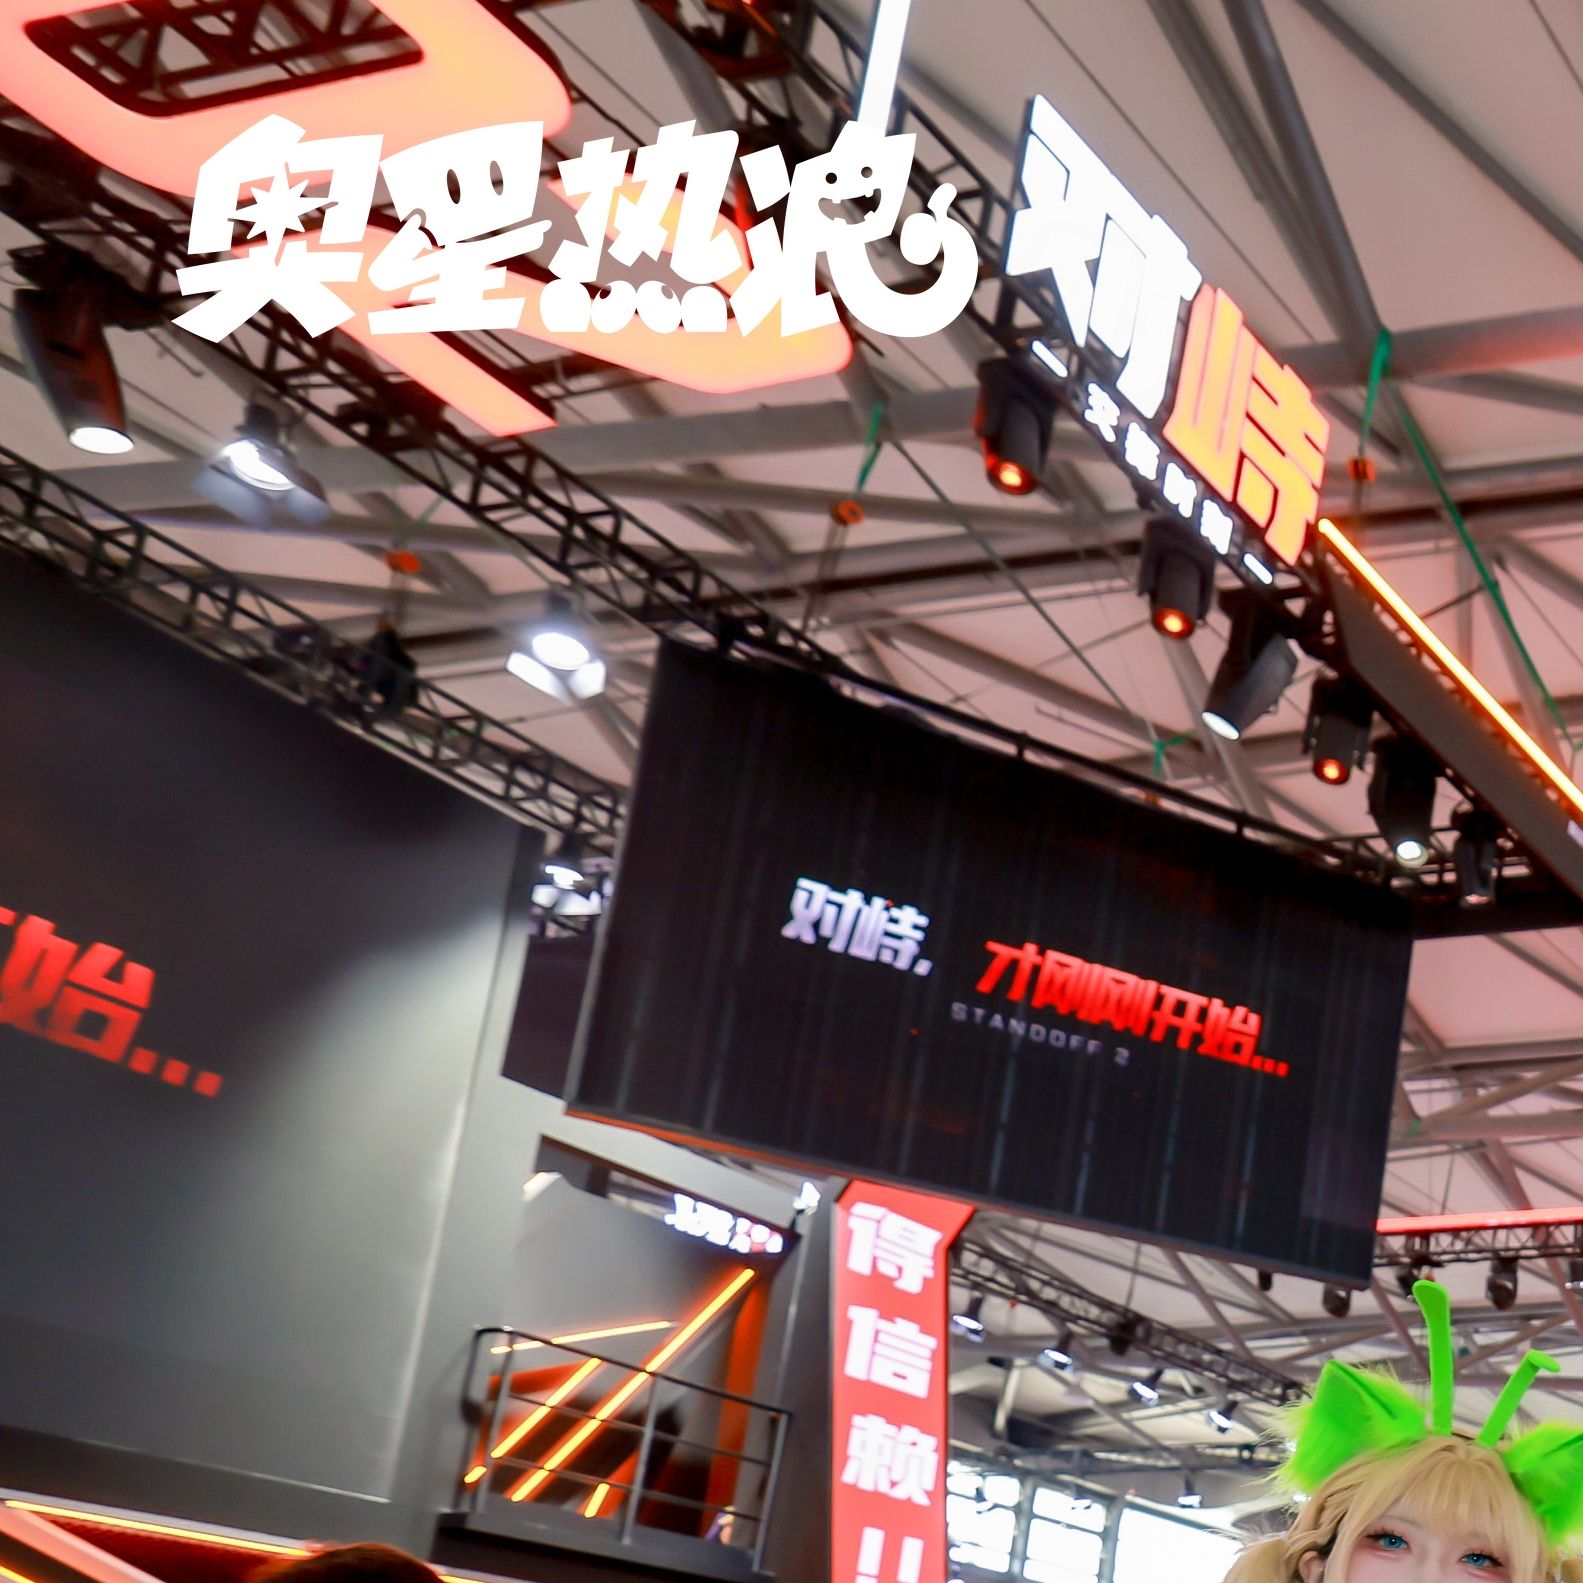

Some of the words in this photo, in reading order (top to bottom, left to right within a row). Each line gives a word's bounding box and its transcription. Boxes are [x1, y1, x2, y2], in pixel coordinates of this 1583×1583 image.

[1005, 94, 1332, 567] 对峙
[0, 905, 224, 1099] 始...
[952, 1000, 1102, 1056] STANDOFF
[1113, 1046, 1130, 1066] 2
